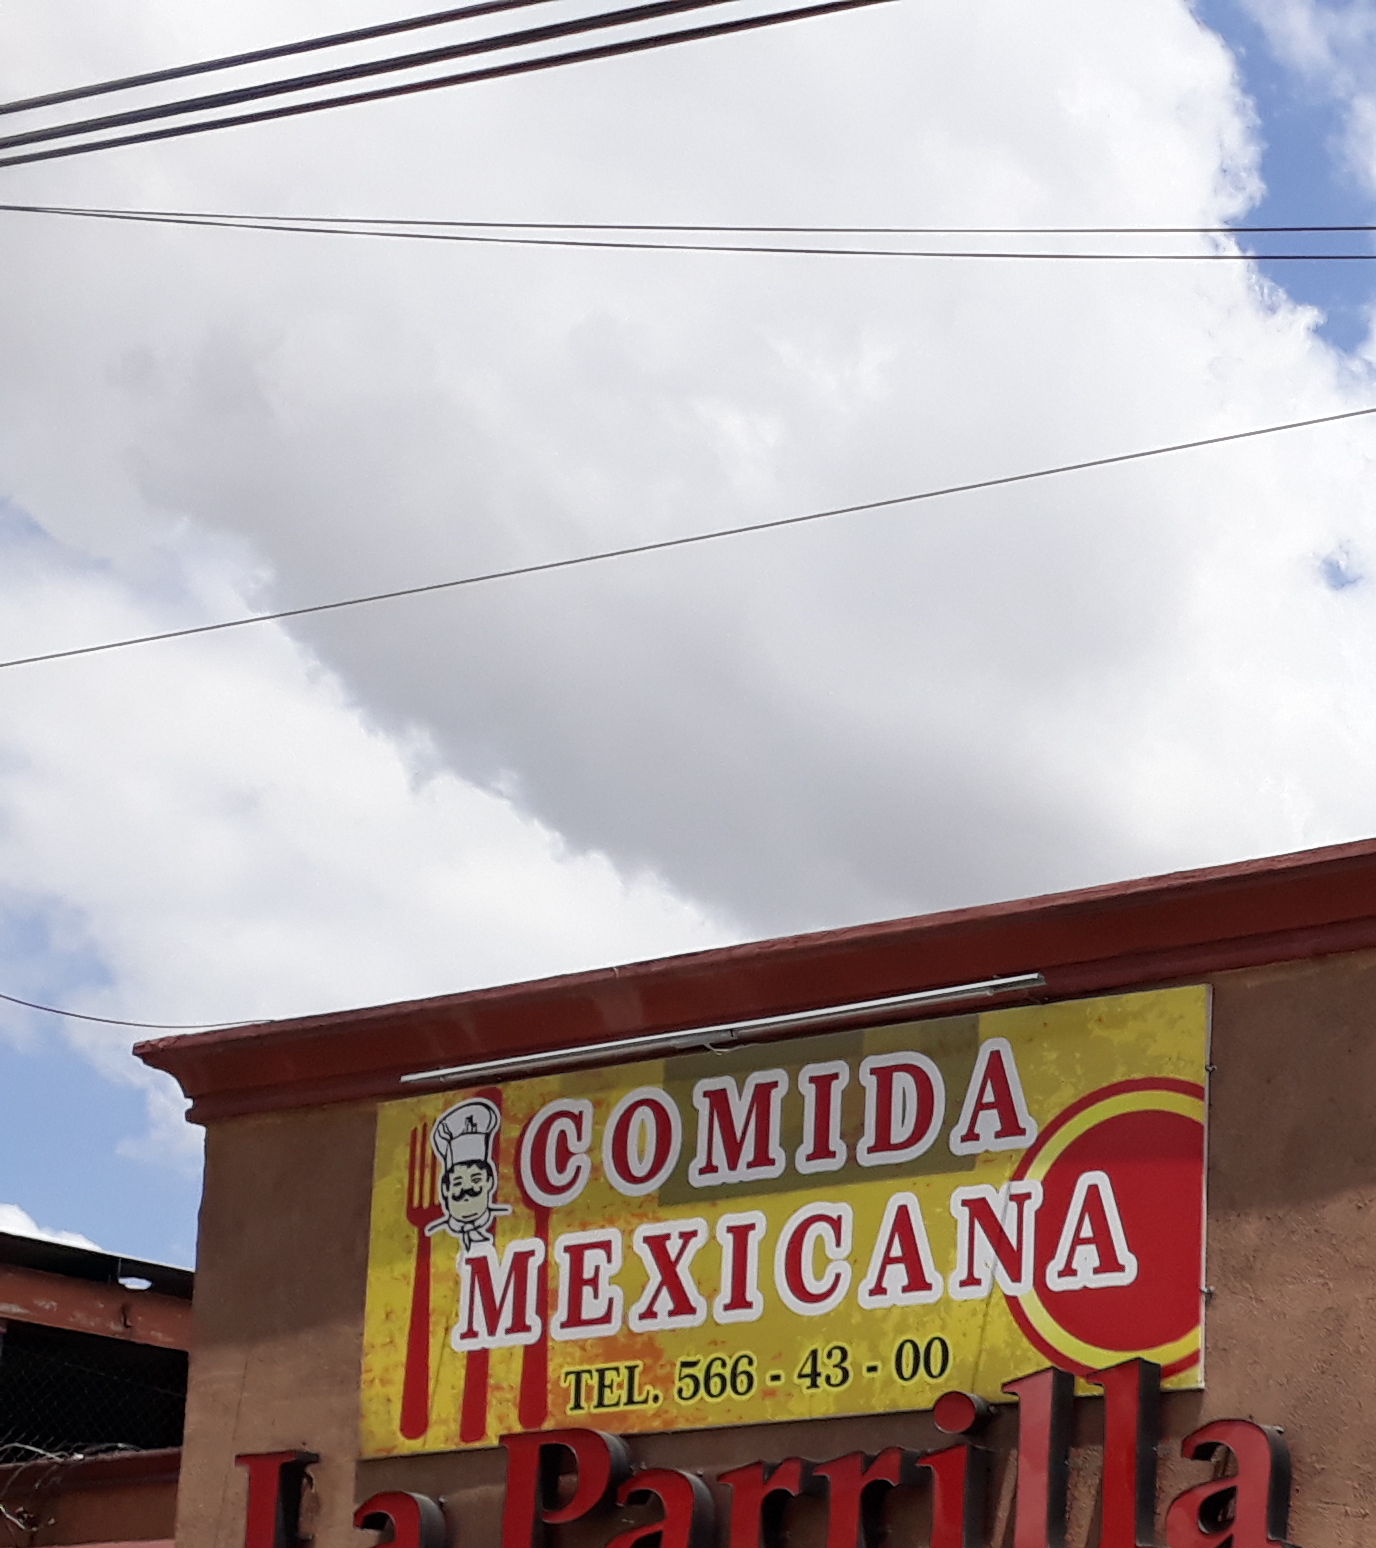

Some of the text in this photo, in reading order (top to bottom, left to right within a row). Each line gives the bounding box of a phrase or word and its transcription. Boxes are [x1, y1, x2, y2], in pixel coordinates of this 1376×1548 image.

[521, 1039, 1035, 1205] COMIDA
[453, 1172, 1136, 1350] MEXICANA
[564, 1366, 661, 1412] TEL.
[677, 1353, 753, 1400] 566
[797, 1345, 850, 1390] 43
[894, 1336, 950, 1382] 00
